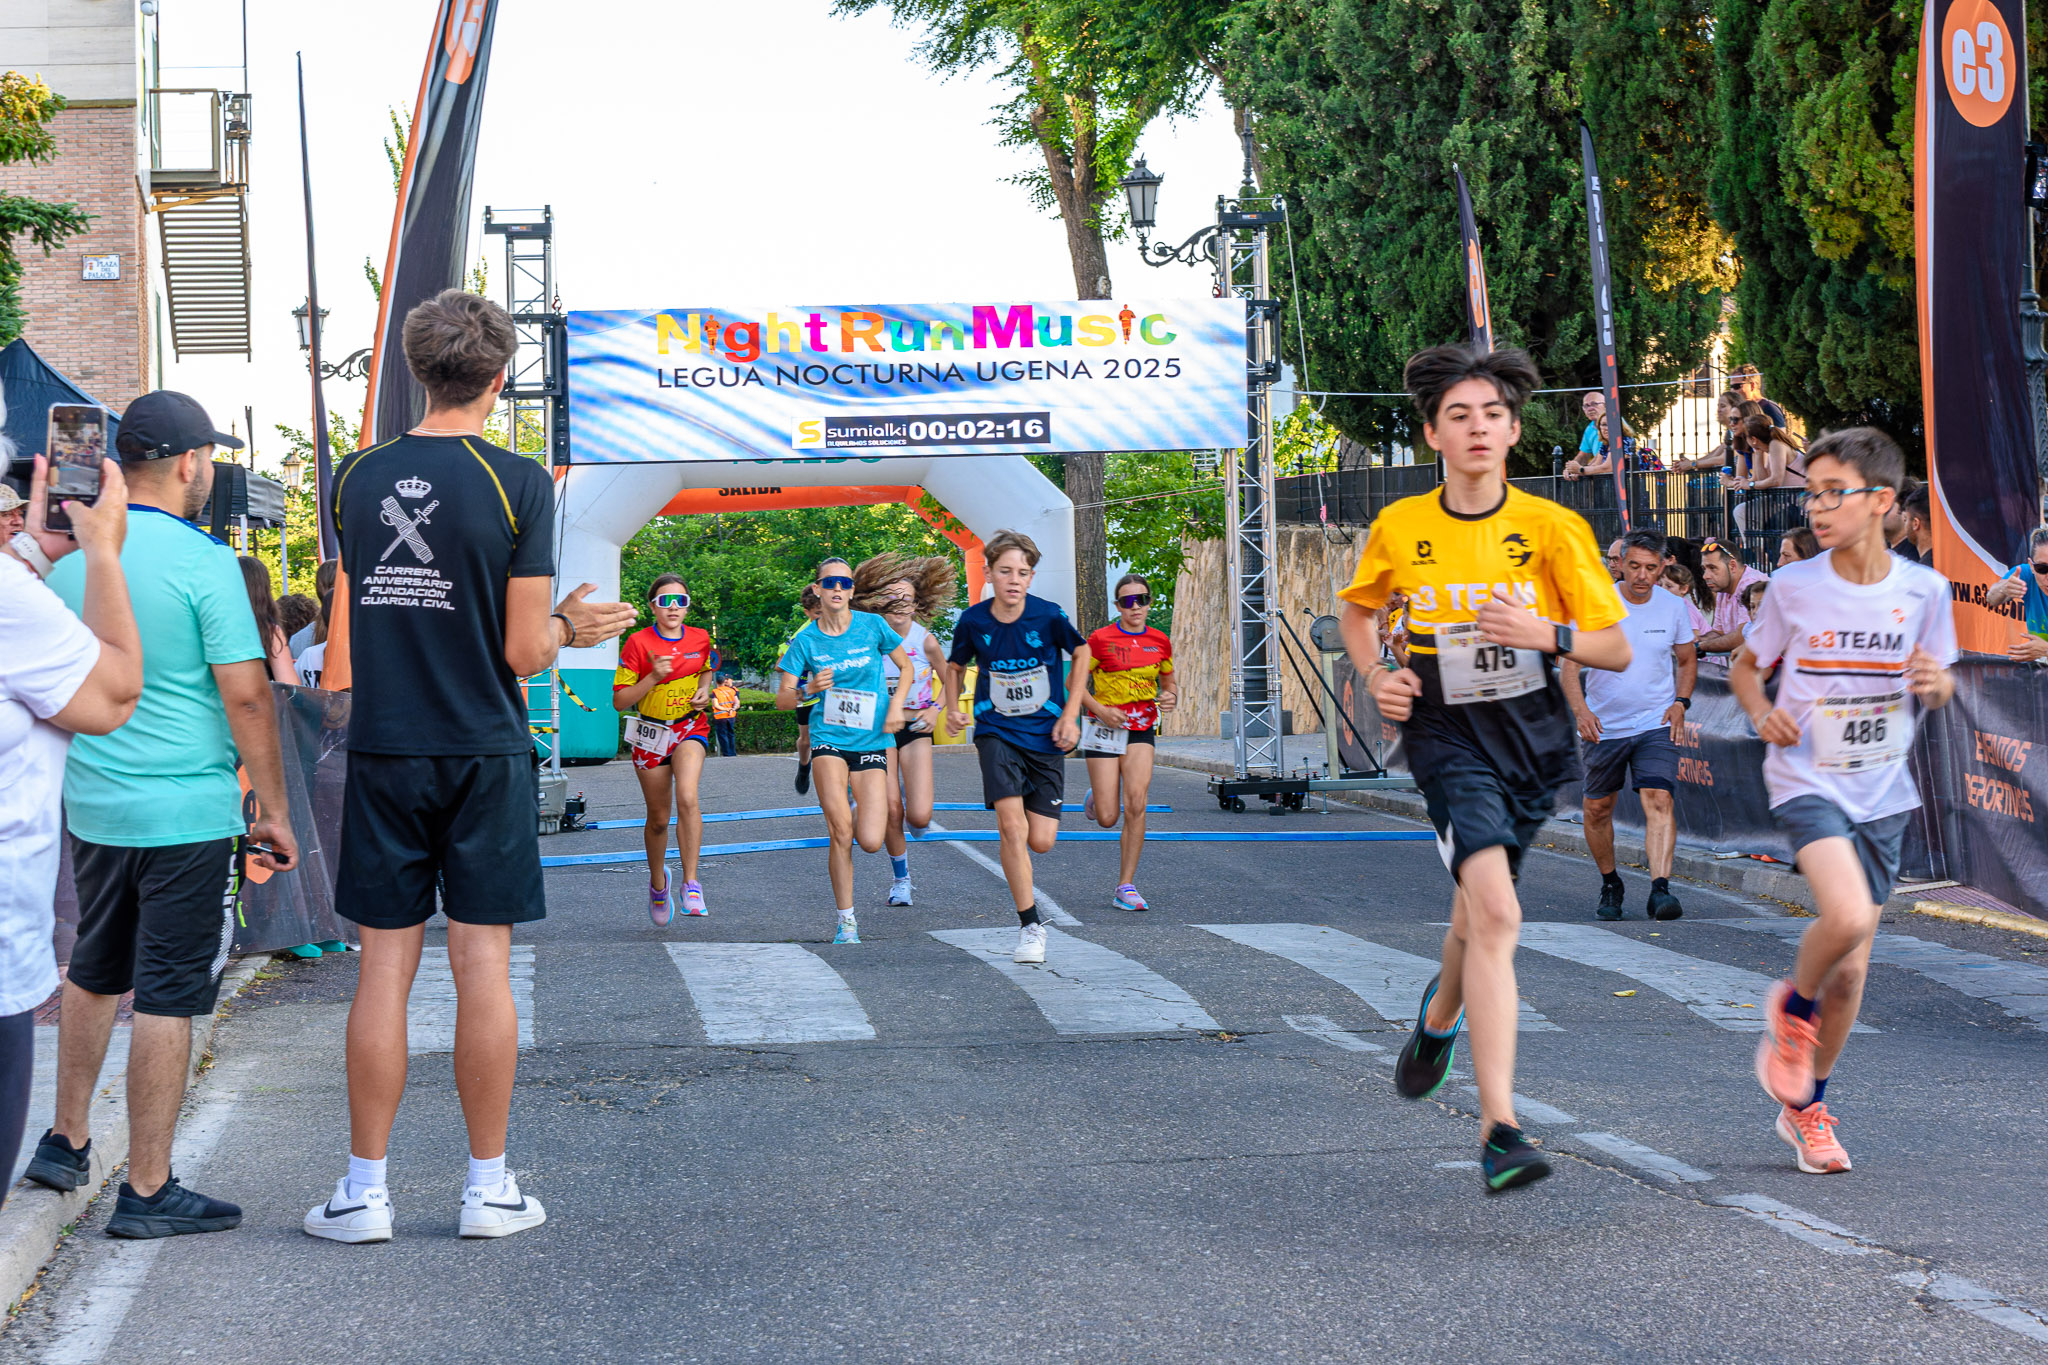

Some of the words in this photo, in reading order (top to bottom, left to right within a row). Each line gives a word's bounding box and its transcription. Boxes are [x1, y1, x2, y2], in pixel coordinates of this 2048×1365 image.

[1952, 21, 2005, 103] e3
[657, 366, 765, 388] LEGUA
[776, 361, 966, 386] NOCTURNA
[976, 358, 1093, 382] UGENA
[1103, 357, 1182, 380] 2025
[826, 422, 907, 438] sumialki
[909, 419, 1044, 441] 00:02:16
[826, 439, 867, 447] ALQUILAMOS
[868, 438, 907, 446] SOLUCIONES
[374, 566, 441, 578] CARRERA
[362, 576, 453, 590] ANIVERSARIO
[368, 586, 447, 599] FUNDACIÓN
[360, 596, 420, 607] GUARDIA
[422, 599, 456, 610] CIVIL
[1474, 645, 1517, 673] 475
[1006, 684, 1033, 702] 489
[838, 699, 861, 715] 484
[636, 723, 657, 740] 490
[1842, 717, 1889, 745] 486
[1974, 729, 2032, 774] EVENTOS
[1964, 772, 2035, 823] DEPORTIVOS
[467, 1191, 483, 1199] NIKE
